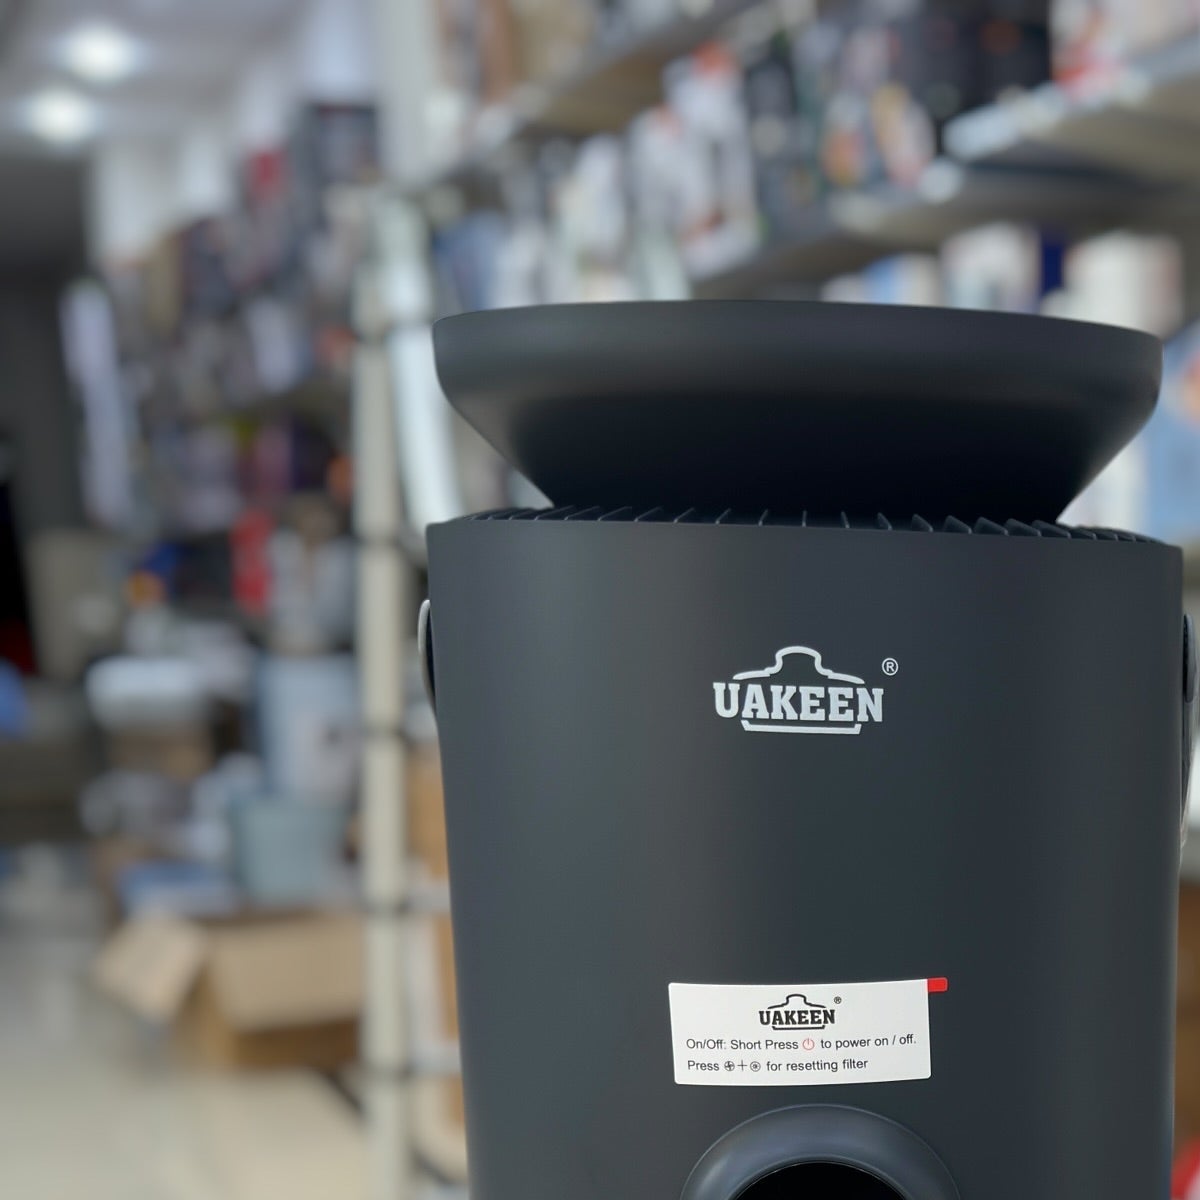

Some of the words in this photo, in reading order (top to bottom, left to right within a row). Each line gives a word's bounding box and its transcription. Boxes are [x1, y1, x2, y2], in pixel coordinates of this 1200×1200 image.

[713, 681, 884, 723] UAKEEN
[758, 1009, 836, 1026] UAKEEN
[686, 1038, 727, 1050] On/Off:
[730, 1039, 762, 1050] Short
[765, 1040, 799, 1050] Press
[820, 1039, 832, 1049] to
[835, 1038, 871, 1049] power
[874, 1037, 889, 1047] on
[899, 1034, 917, 1045] off.
[687, 1061, 719, 1071] Press
[766, 1061, 782, 1072] for
[786, 1060, 838, 1073] resetting
[842, 1058, 868, 1070] filter
